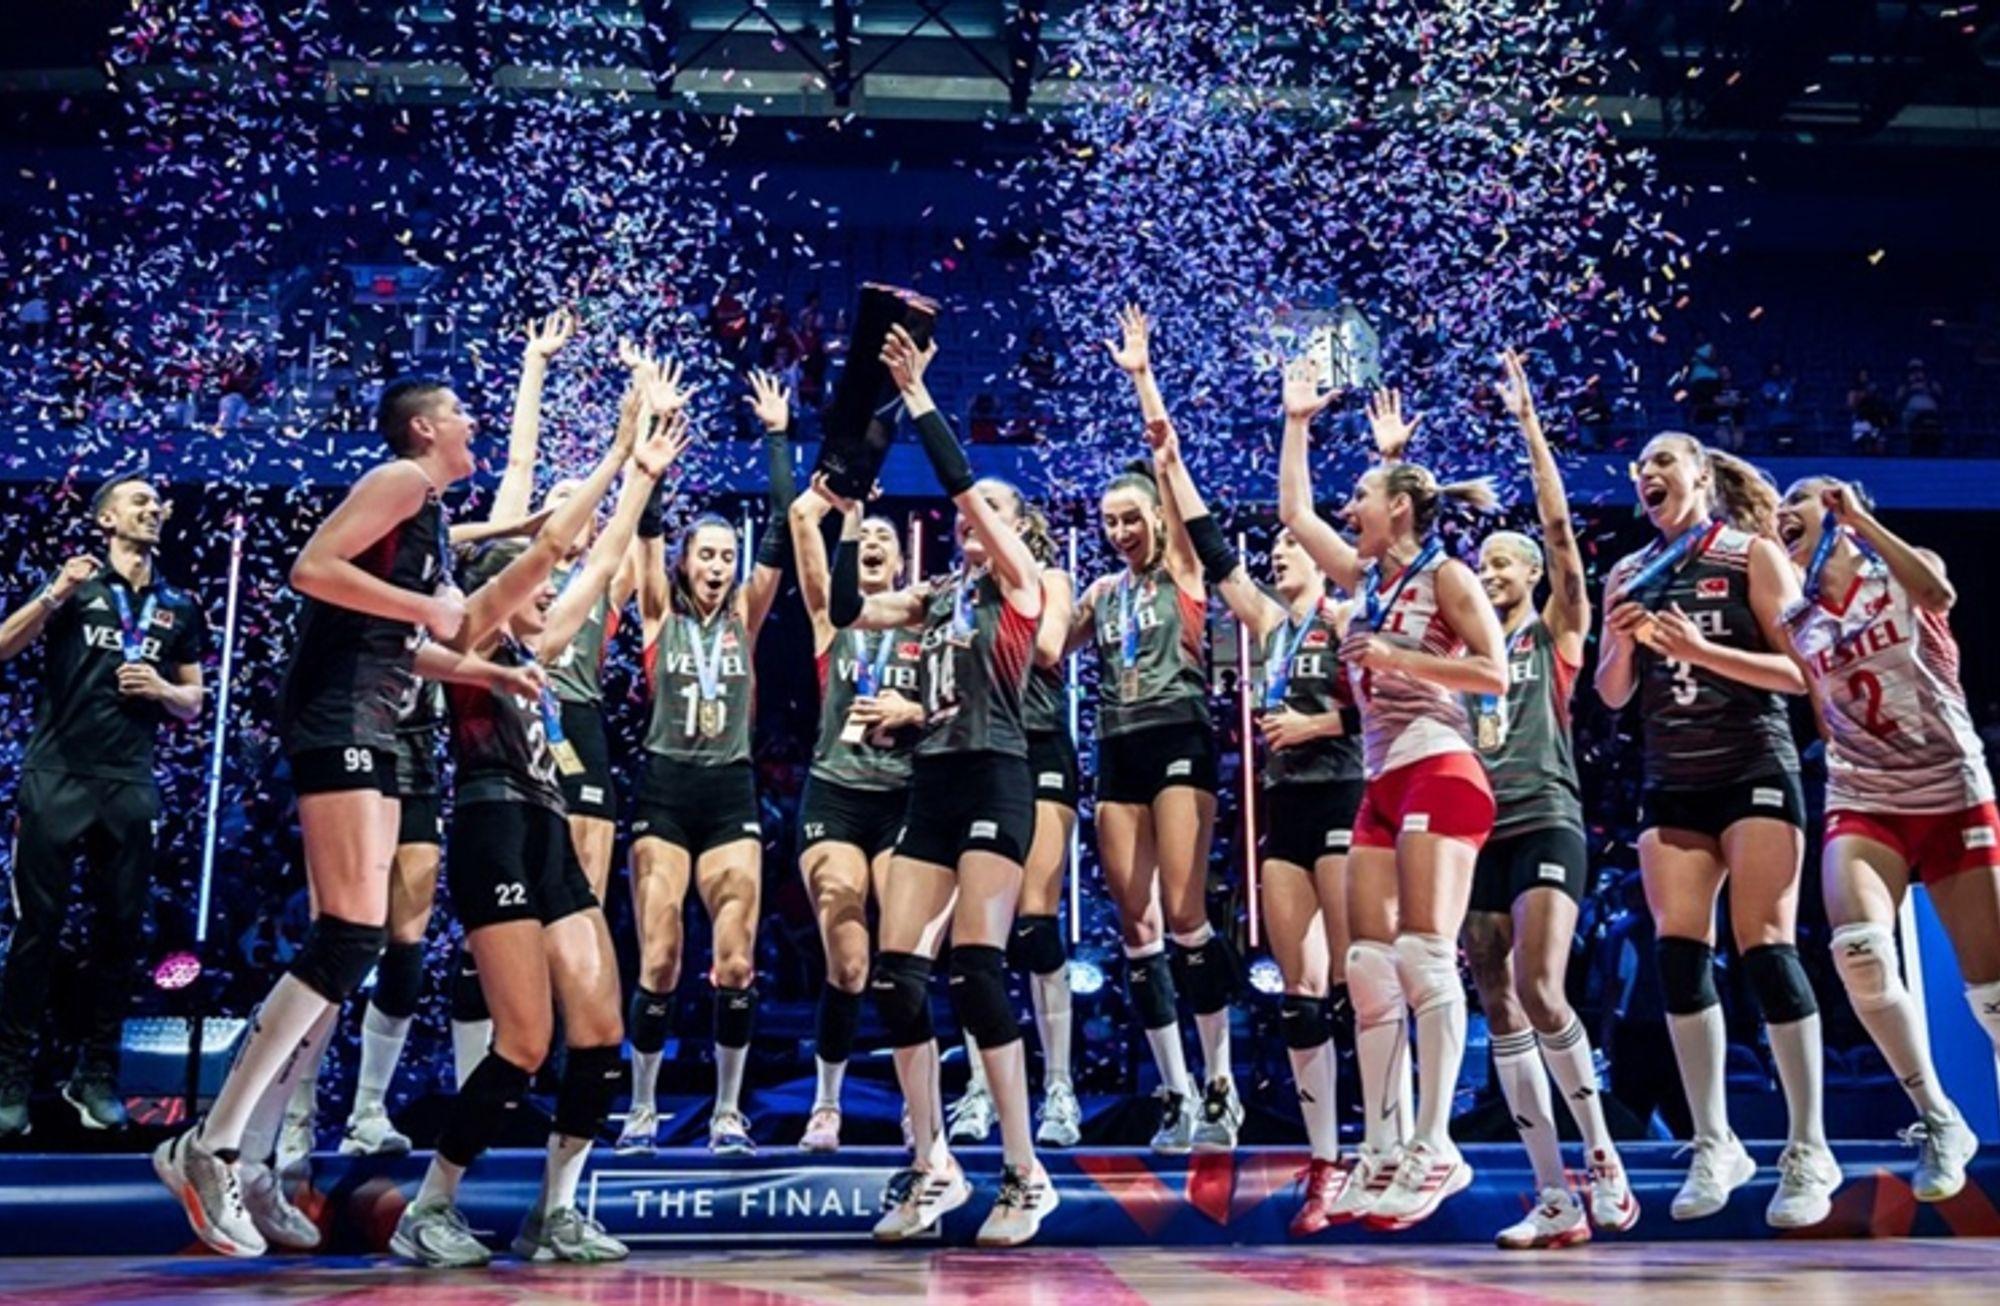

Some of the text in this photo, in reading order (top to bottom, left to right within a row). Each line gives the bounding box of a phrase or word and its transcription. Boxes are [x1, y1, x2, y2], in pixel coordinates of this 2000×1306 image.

[82, 624, 161, 661] VESEL
[667, 652, 747, 676] VEEL
[1666, 655, 1698, 706] 3
[1848, 669, 1899, 736] 2
[343, 746, 374, 773] 99
[494, 883, 528, 907] 22
[631, 1189, 714, 1218] THE
